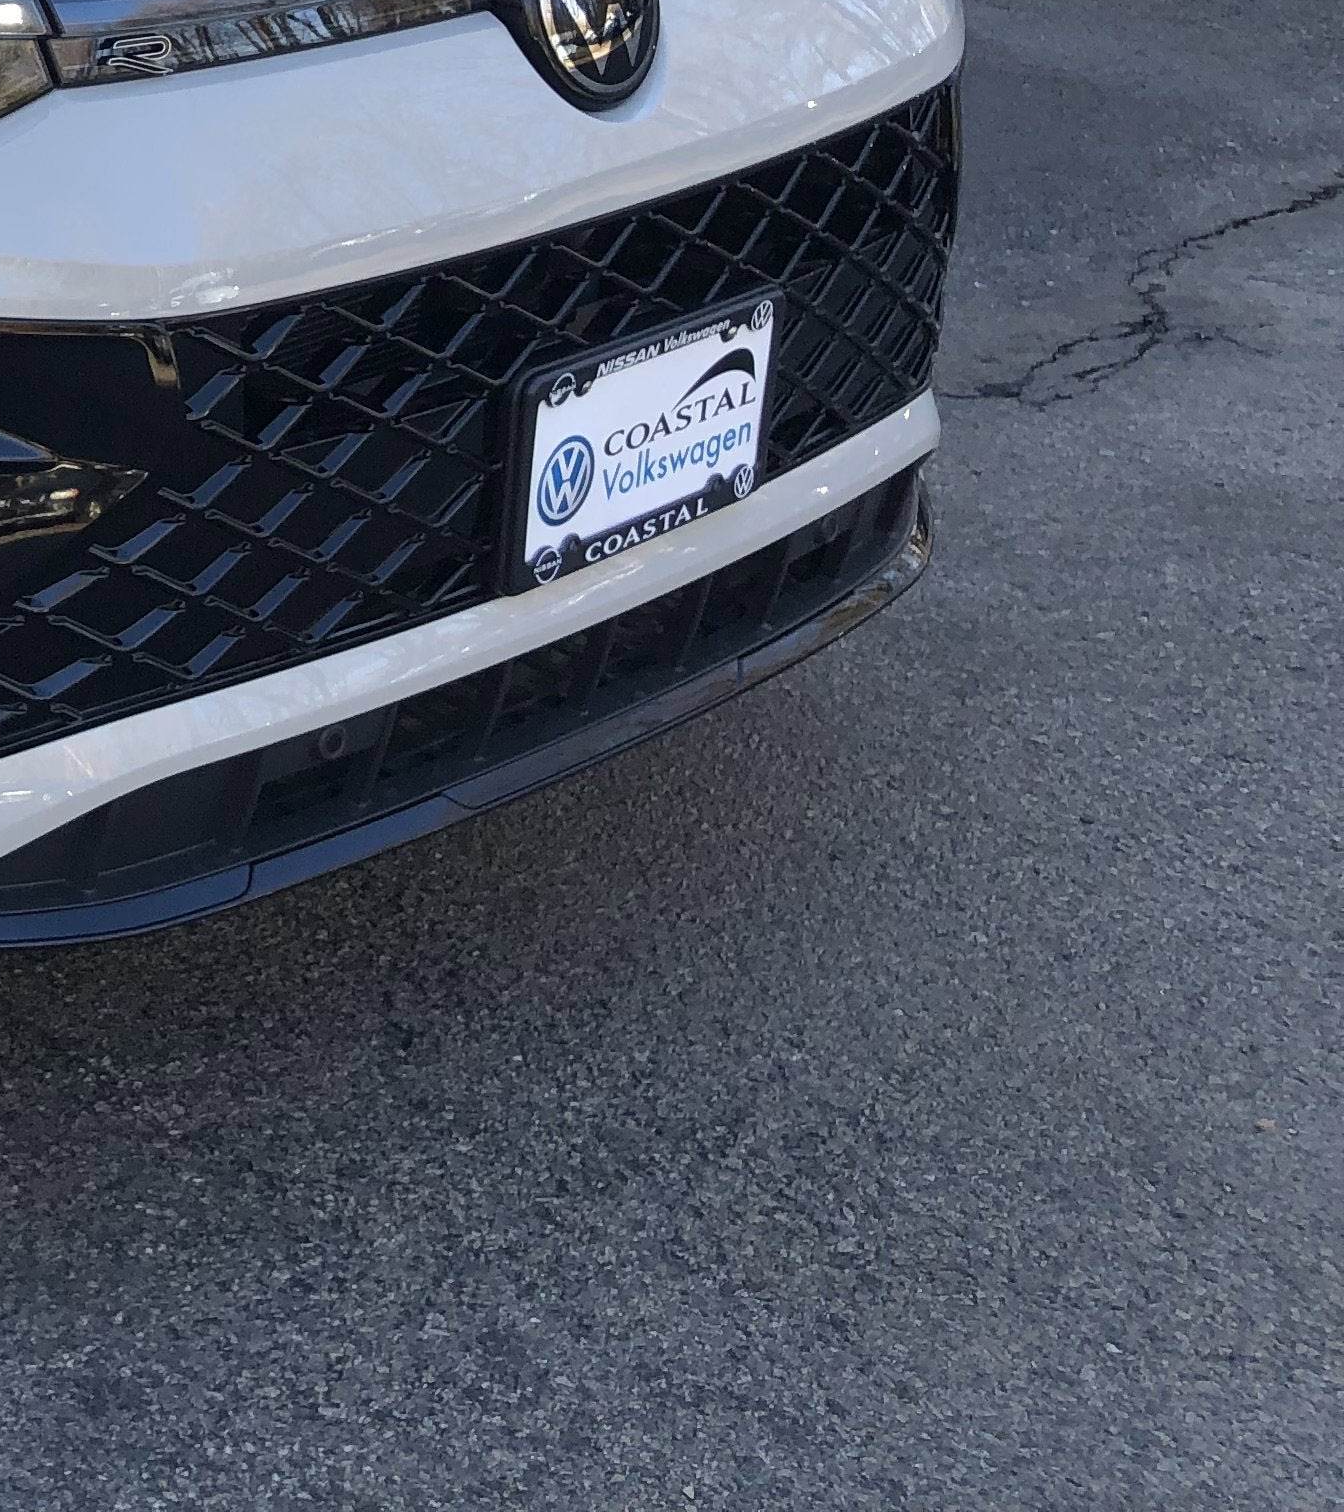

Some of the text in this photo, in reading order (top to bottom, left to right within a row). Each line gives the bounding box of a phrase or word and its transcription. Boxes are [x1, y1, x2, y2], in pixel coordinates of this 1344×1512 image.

[596, 318, 731, 377] NISSAN Volkswagen
[603, 381, 756, 456] COASTAL
[602, 421, 752, 500] Volkswagen
[584, 497, 708, 563] COASTAL
